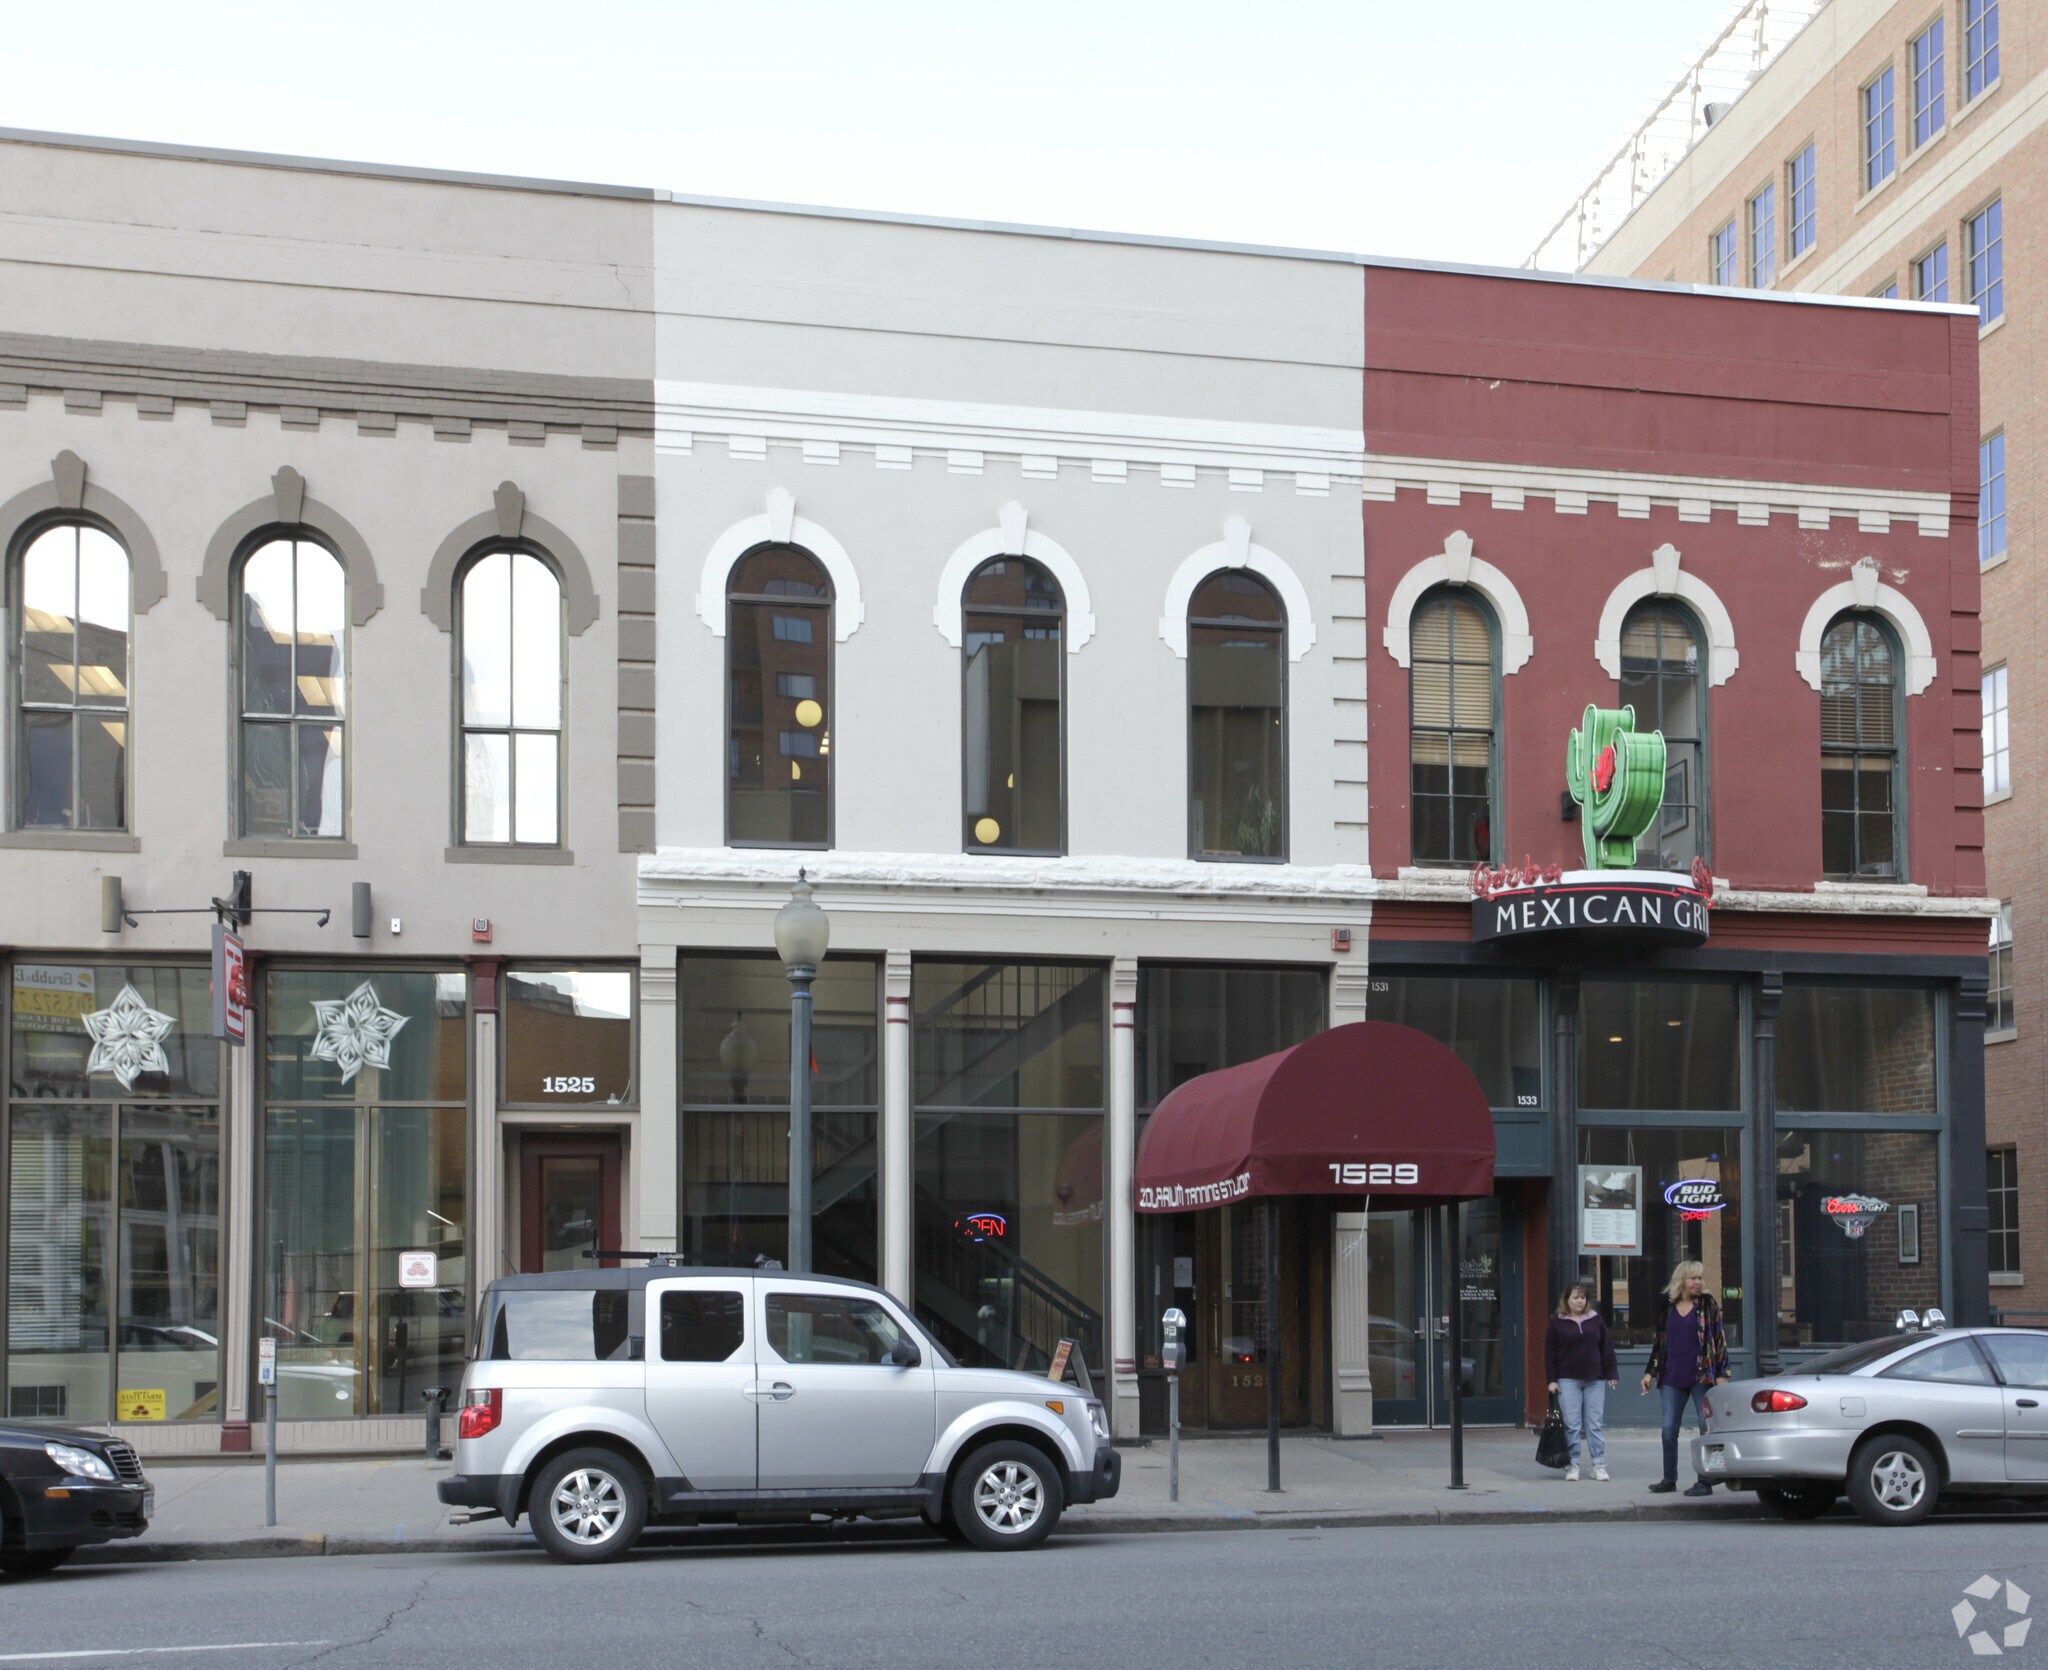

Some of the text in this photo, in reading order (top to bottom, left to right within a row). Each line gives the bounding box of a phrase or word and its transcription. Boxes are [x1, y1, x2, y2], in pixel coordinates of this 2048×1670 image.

[1496, 895, 1661, 933] MEXICAN
[1371, 981, 1389, 991] 1531
[542, 1076, 595, 1094] 1525
[1517, 1095, 1538, 1106] 1533
[1328, 1163, 1419, 1185] 1529
[1680, 1184, 1716, 1195] BUD
[1673, 1193, 1723, 1204] LIGHT
[1827, 1199, 1890, 1213] Coors LIGHT
[1680, 1211, 1712, 1221] OPEN
[1232, 1374, 1268, 1387] 152
